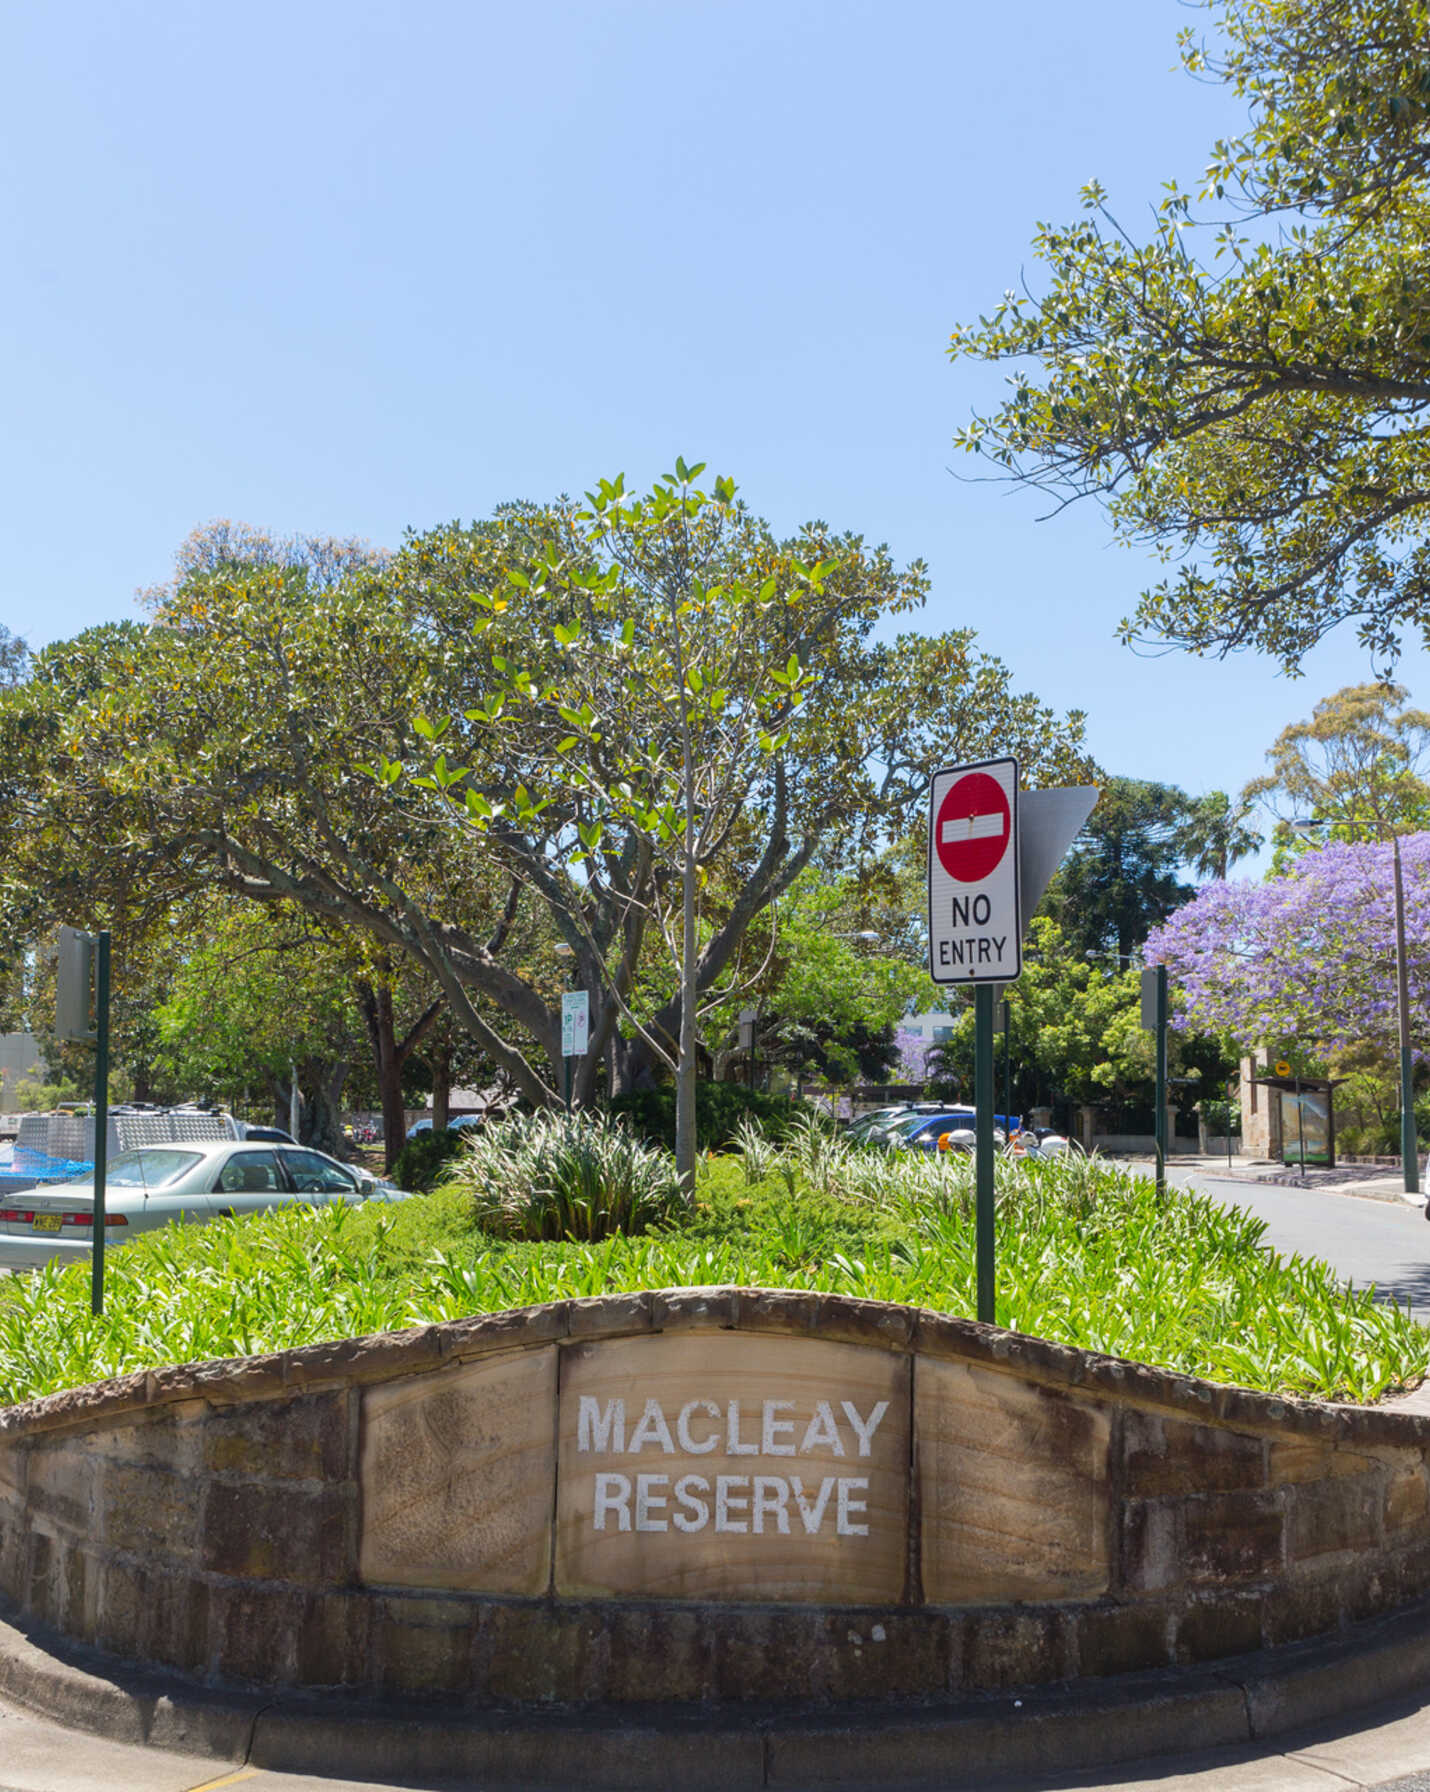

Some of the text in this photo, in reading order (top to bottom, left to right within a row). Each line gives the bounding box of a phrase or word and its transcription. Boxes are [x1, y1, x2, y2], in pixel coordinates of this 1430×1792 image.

[952, 894, 991, 928] NO
[940, 937, 1007, 965] ENTRY
[577, 1396, 890, 1457] MACLEAY
[593, 1472, 869, 1536] RESERVE
